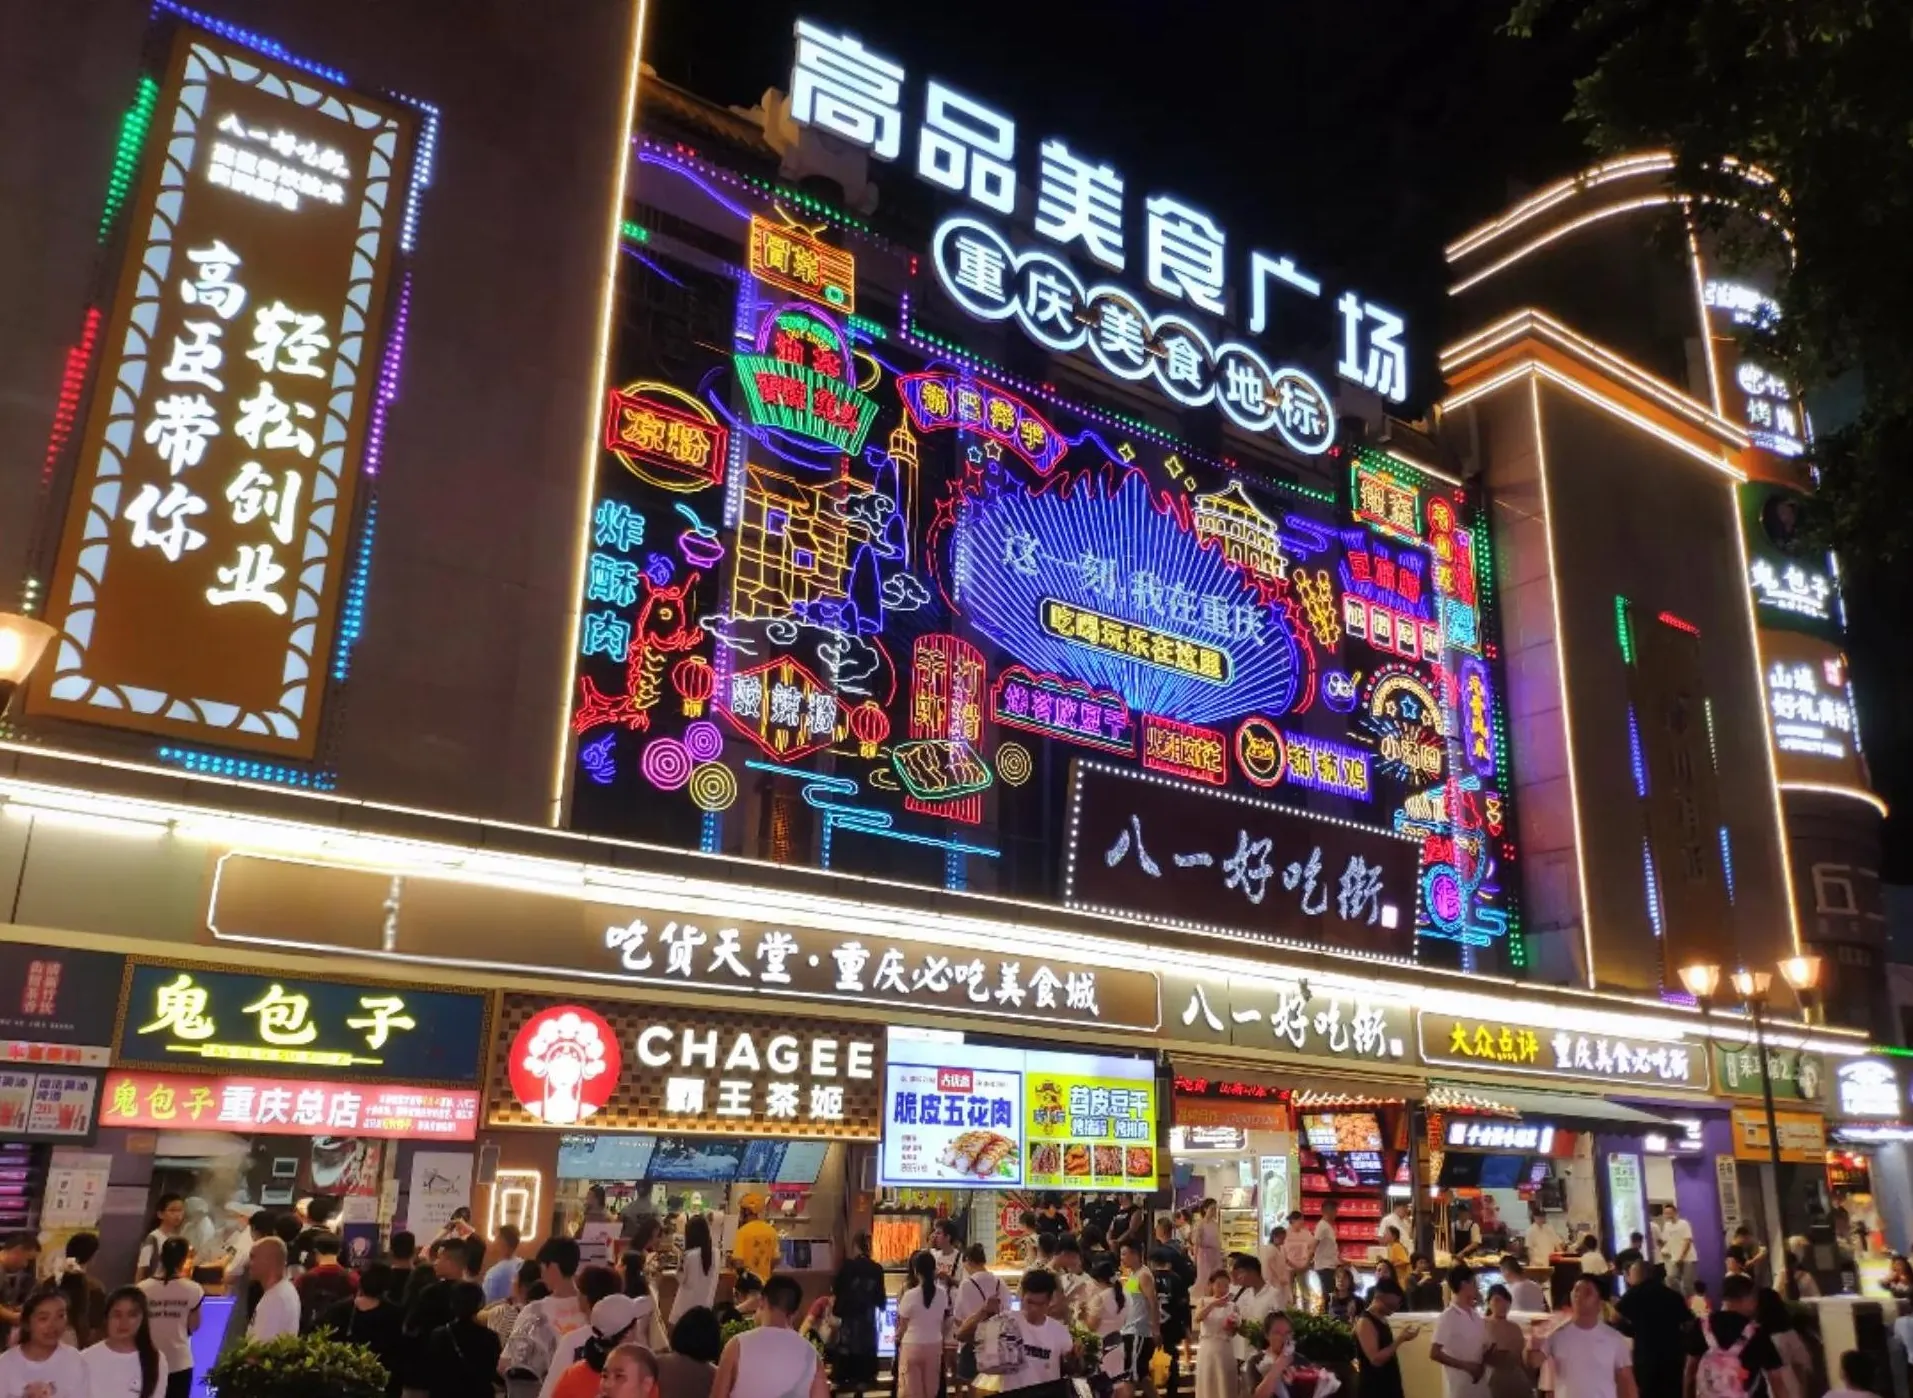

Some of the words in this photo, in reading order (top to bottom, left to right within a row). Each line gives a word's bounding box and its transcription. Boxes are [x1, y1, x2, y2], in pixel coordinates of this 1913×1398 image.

[790, 20, 1409, 402] 高品美食广场
[955, 235, 1326, 437] 重庆美食地标
[123, 239, 247, 563] 高臣带你
[206, 301, 331, 616] 轻松创业
[582, 500, 645, 662] 炸酥肉
[1106, 814, 1384, 925] 八一好吃街
[605, 918, 1101, 1017] 吃货天堂·重庆必吃美食城
[138, 974, 416, 1050] 鬼包子
[637, 1024, 875, 1079] CHAGEE
[1182, 984, 1388, 1056] 八一好吃街
[1450, 1021, 1539, 1064] 大众点评
[105, 1077, 216, 1122] 鬼包子
[216, 1083, 362, 1129] 重庆总店
[666, 1077, 845, 1120] 霸王茶姬
[893, 1091, 1012, 1129] 脆皮五花肉
